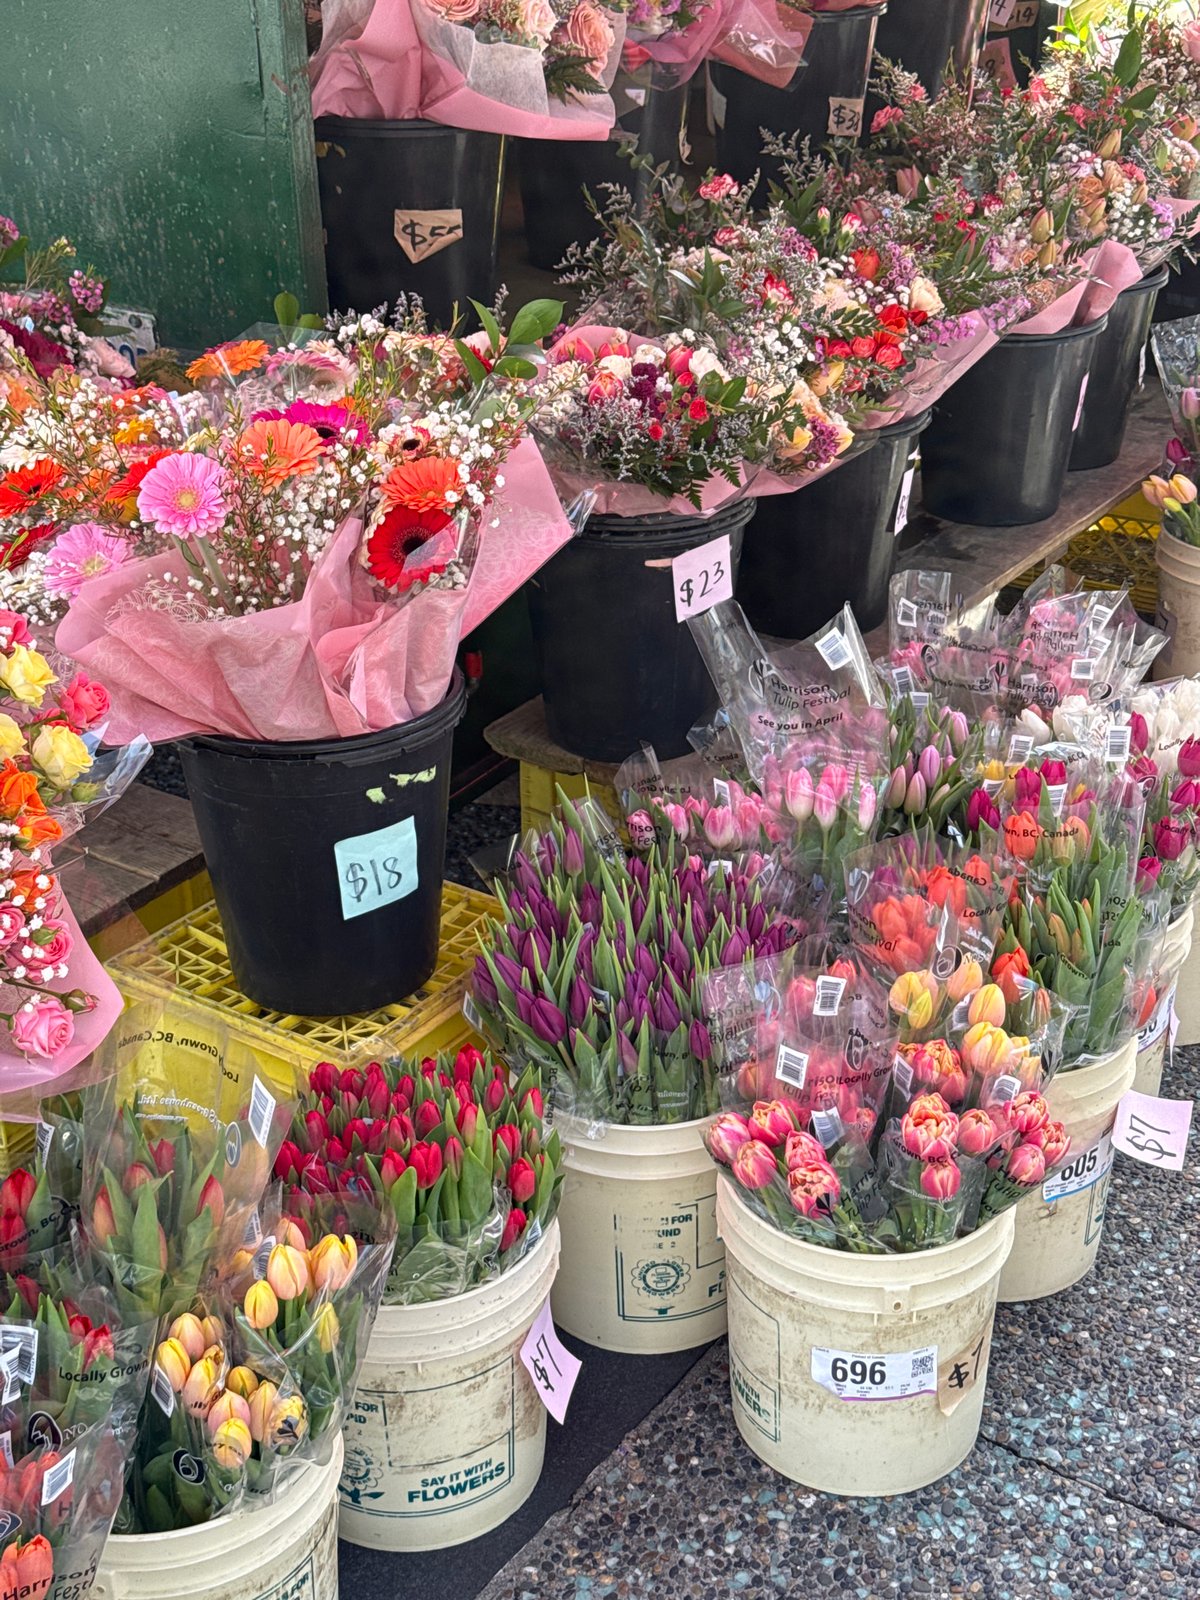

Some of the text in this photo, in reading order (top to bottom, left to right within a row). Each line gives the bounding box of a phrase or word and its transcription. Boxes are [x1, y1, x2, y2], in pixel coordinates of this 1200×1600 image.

[679, 560, 725, 608] $23
[770, 678, 831, 697] Harrison
[1007, 679, 1058, 693] Harrison
[772, 686, 852, 712] Tulip Festival
[757, 712, 844, 731] See you in April
[1022, 829, 1040, 839] BC,
[1042, 826, 1079, 839] Canada
[345, 856, 403, 903] $18
[963, 907, 994, 919] Locally
[838, 1071, 873, 1086] Locally
[1125, 1113, 1177, 1161] $7
[671, 1213, 693, 1226] FOR
[59, 1360, 149, 1384] Locally Grown
[530, 1333, 563, 1393] $7
[831, 1357, 887, 1386] 696
[354, 1400, 379, 1413] FOR
[408, 1461, 506, 1503] FLOWERS
[421, 1457, 493, 1488] SAY IT WITH
[3, 1563, 97, 1600] Harrison
